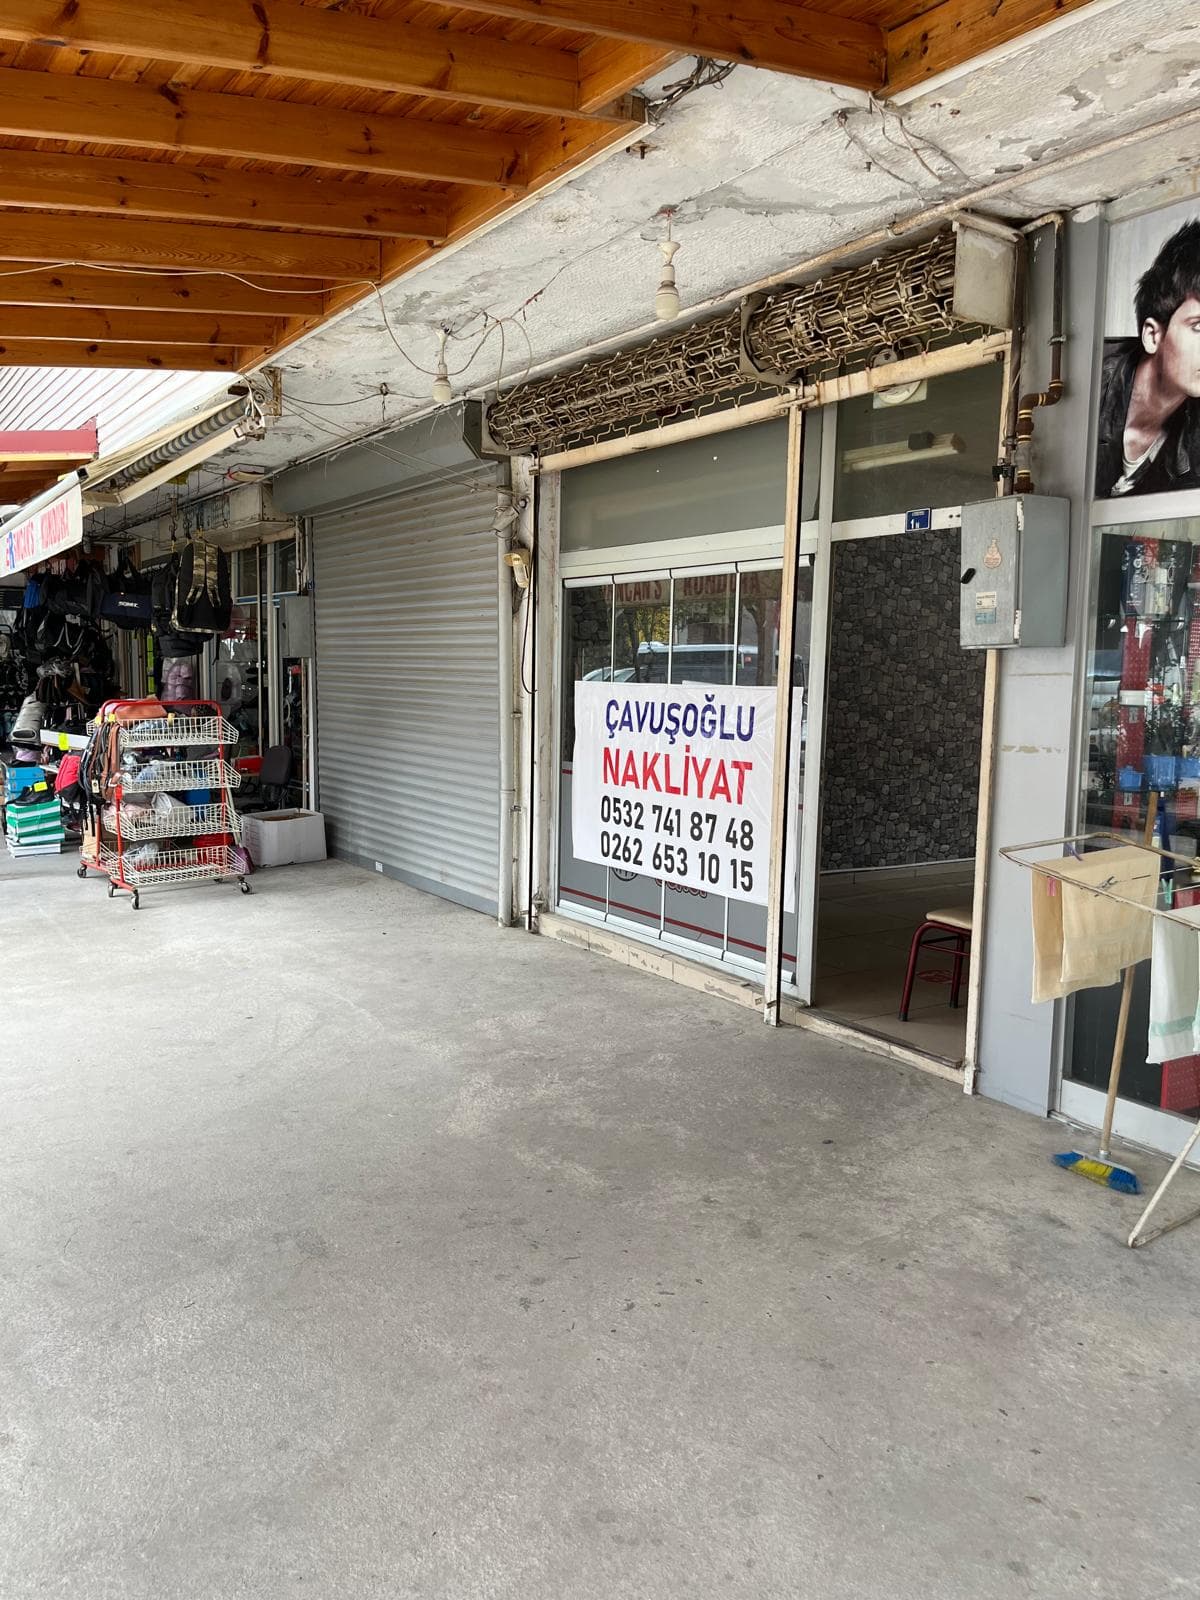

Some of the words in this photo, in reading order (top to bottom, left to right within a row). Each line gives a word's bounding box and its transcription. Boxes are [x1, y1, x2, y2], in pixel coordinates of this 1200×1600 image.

[605, 694, 755, 745] ÇAVUŞOĞLU
[603, 744, 753, 805] NAKLİYAT
[600, 795, 644, 830] 0532
[652, 804, 681, 837] 741
[690, 811, 717, 843] 87
[725, 817, 754, 851] 48
[600, 830, 643, 866] 0262
[652, 842, 688, 876] 653
[698, 851, 720, 884] 10
[730, 858, 754, 892] 15
